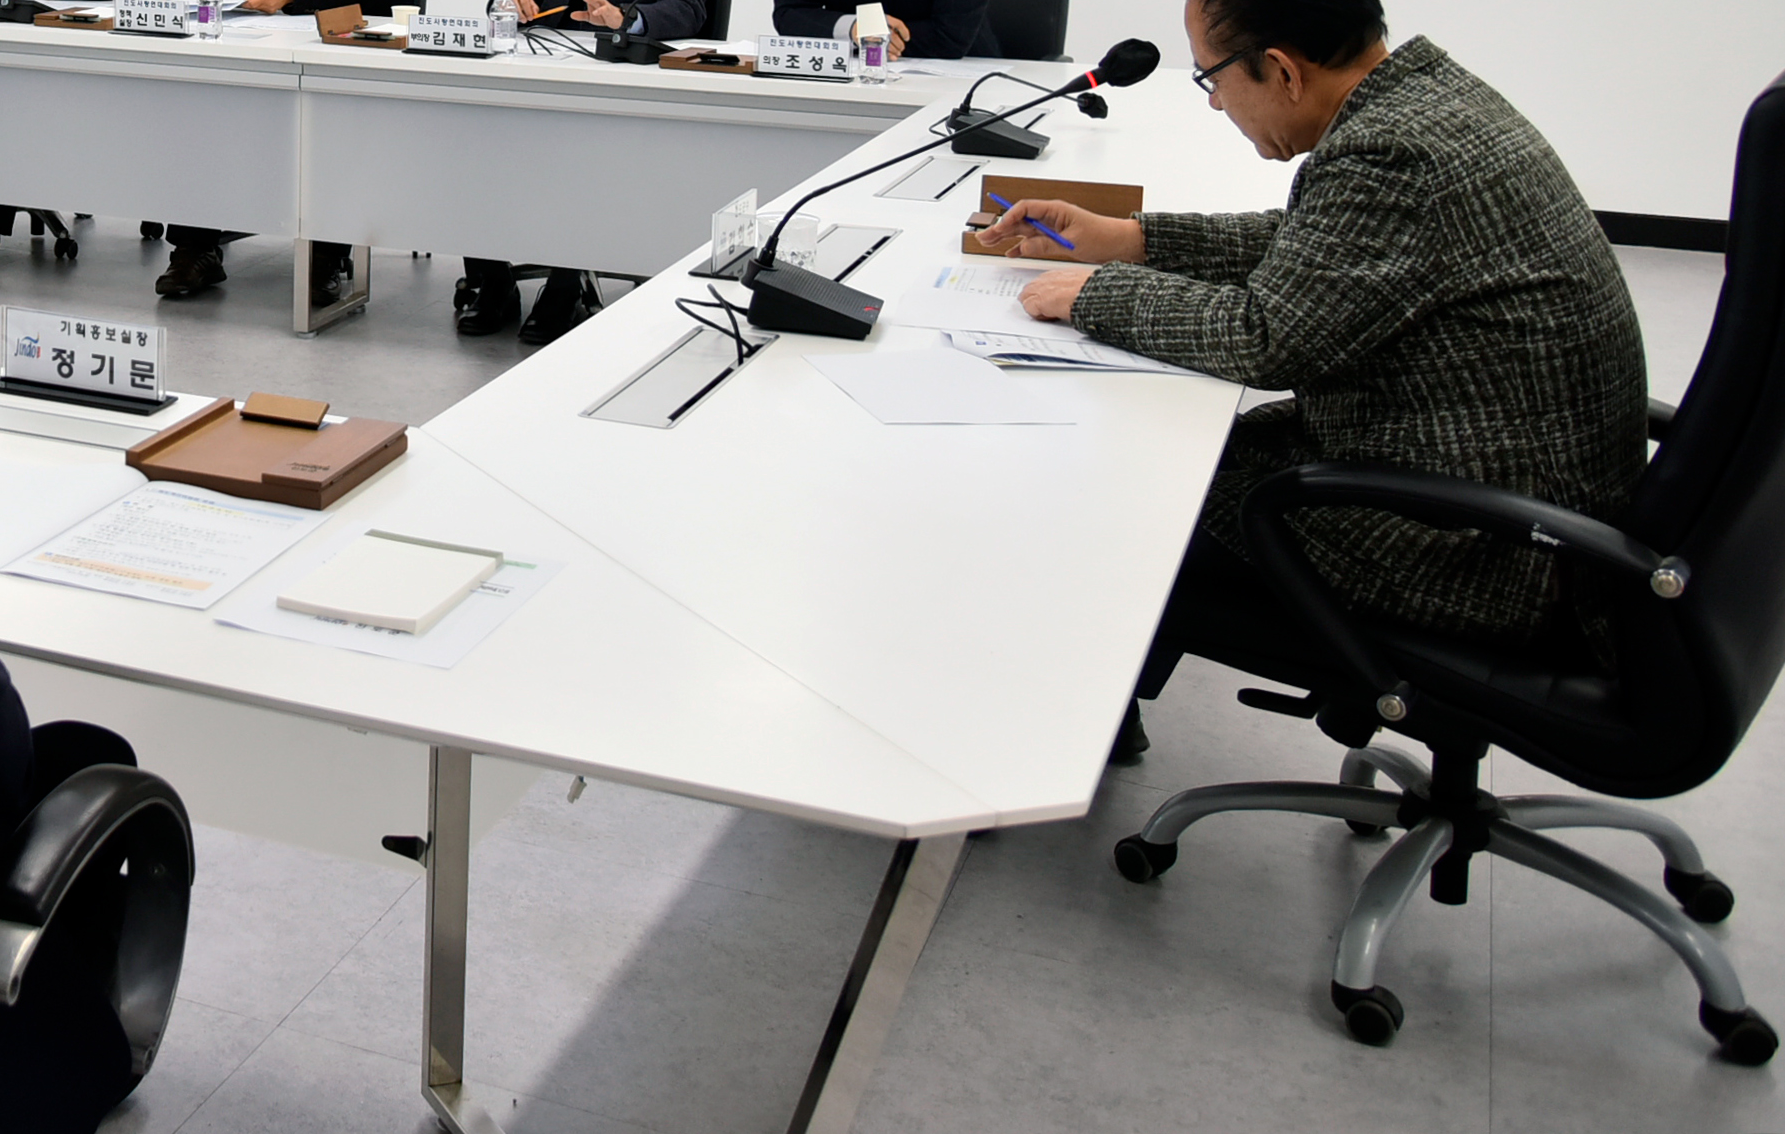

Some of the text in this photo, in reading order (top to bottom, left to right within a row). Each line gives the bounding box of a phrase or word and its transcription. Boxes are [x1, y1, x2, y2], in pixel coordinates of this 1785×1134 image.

[123, 0, 177, 10] 진도사랑연대회의
[135, 12, 184, 29] 신민식
[418, 16, 479, 28] 진도사랑연대회의
[432, 31, 486, 49] 김재현
[770, 38, 839, 51] 진도사랑연대회의
[762, 54, 848, 73] 의장 조성옥
[60, 320, 148, 348] 기획홍보실장
[14, 336, 38, 359] Jindo
[51, 347, 155, 391] 정기문
